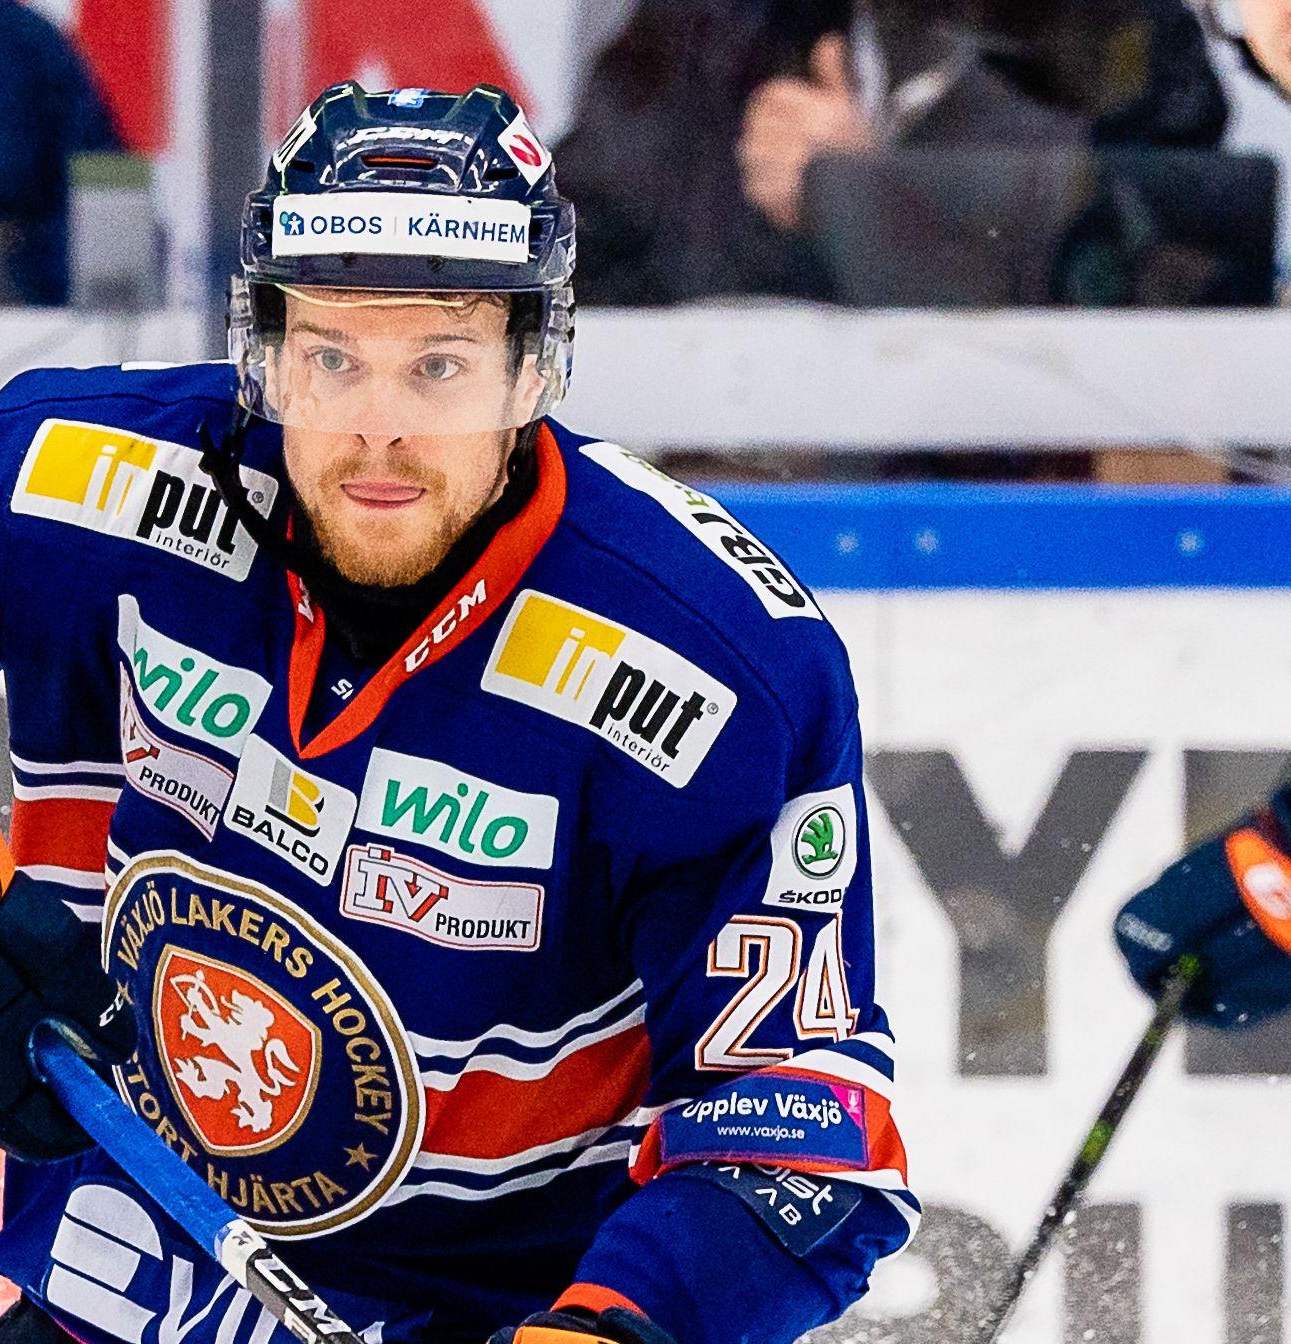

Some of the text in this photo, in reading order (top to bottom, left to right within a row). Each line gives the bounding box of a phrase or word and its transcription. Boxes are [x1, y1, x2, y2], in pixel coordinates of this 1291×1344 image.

[310, 212, 526, 245] OBOS KÄRNHEM
[155, 530, 230, 569] interiör
[404, 578, 488, 673] CCM
[133, 646, 252, 739] wilo
[542, 627, 707, 760] input
[605, 723, 671, 774] interiör
[138, 766, 223, 826] PRODUKT
[380, 778, 529, 859] wilo
[230, 807, 330, 876] BALCO
[435, 912, 532, 940] PRODUKT
[777, 888, 844, 905] ŠKOD
[117, 880, 392, 1136] VÄXJÖ LAKERS HOCKEY
[694, 909, 861, 1072] 24
[126, 1053, 348, 1216] TORT HJÄRTA
[682, 1091, 843, 1129] Upplev Växjö
